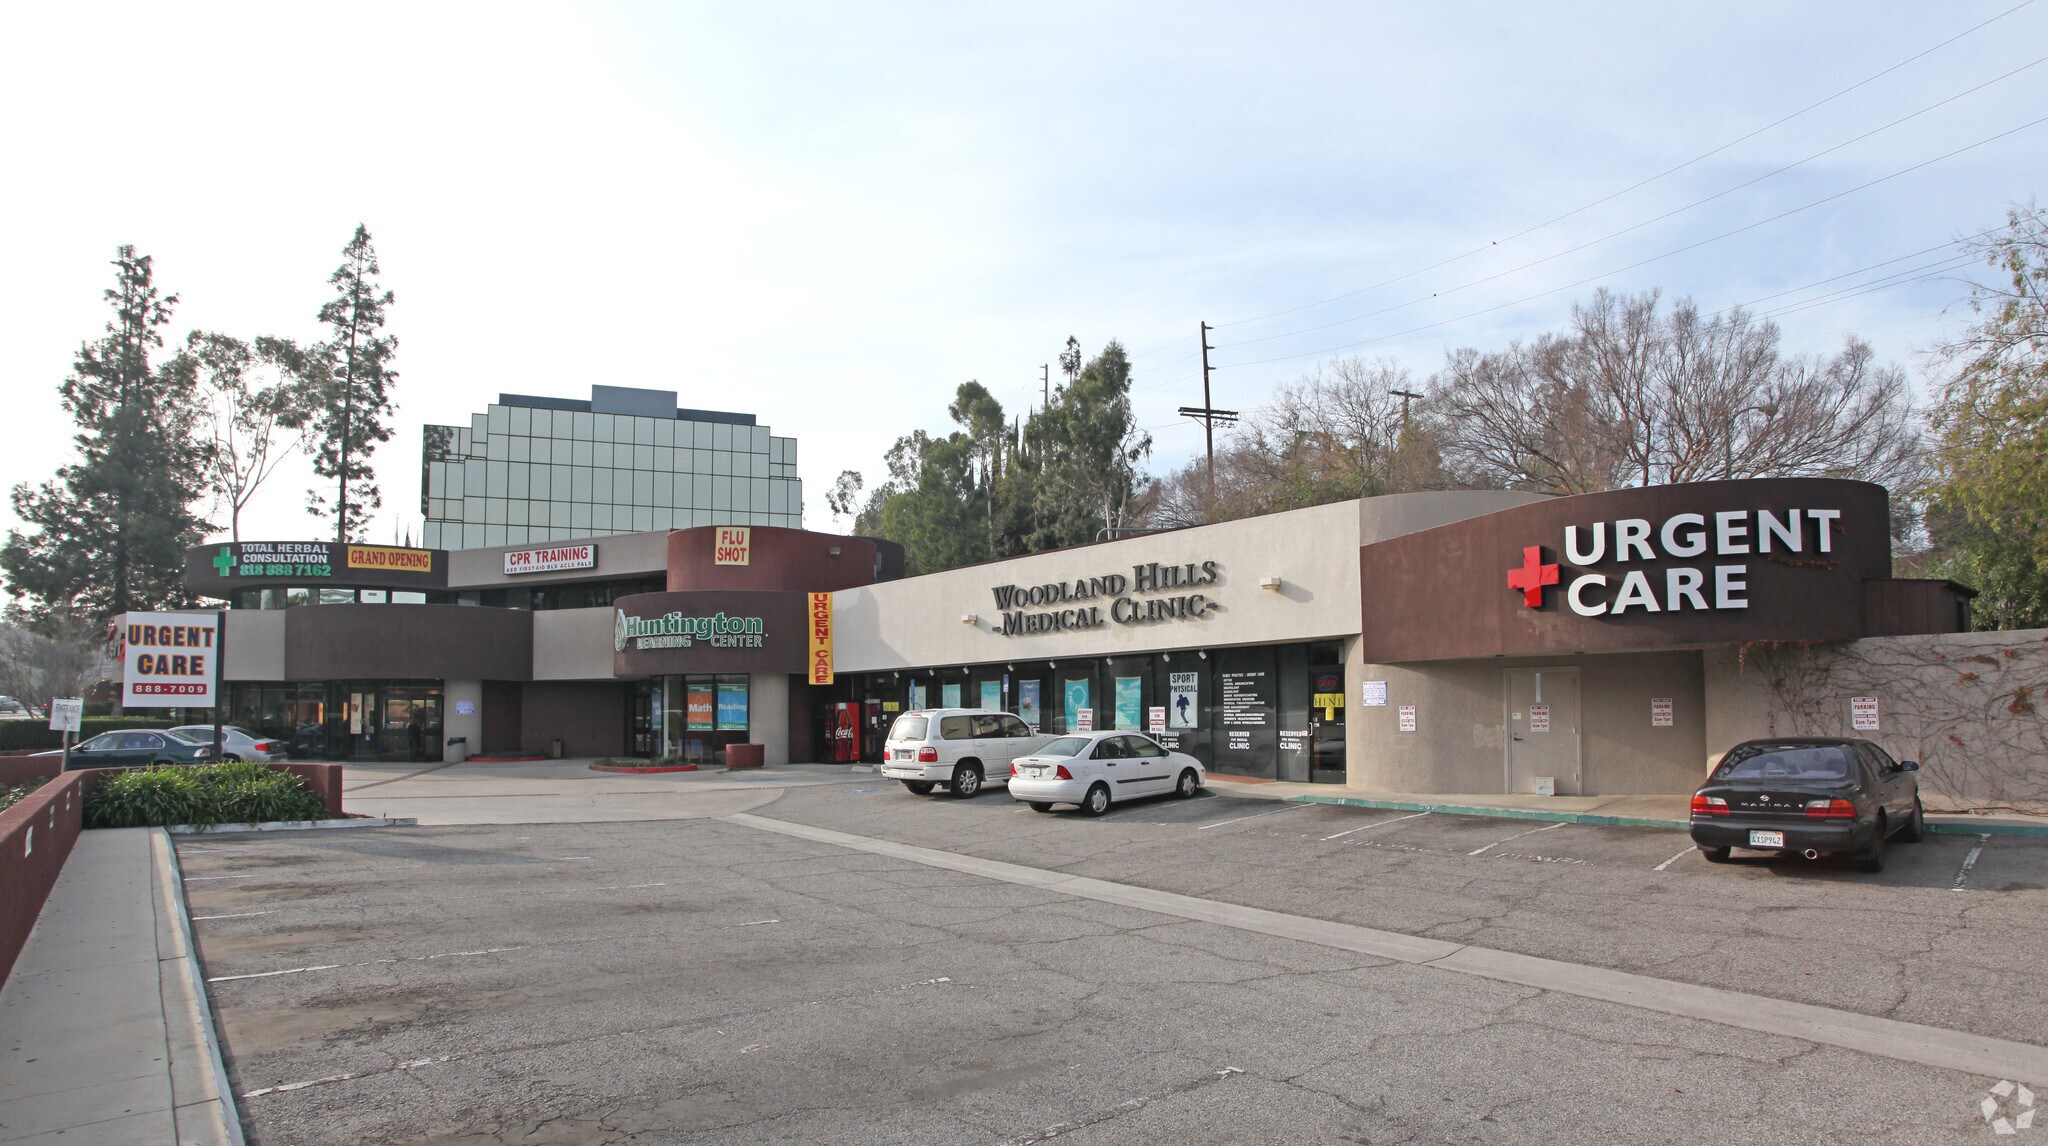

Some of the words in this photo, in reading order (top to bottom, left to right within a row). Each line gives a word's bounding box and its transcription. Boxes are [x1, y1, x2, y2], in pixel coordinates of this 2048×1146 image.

[721, 531, 744, 545] FLU
[1565, 509, 1841, 566] URGENT
[241, 544, 273, 553] TOTAL
[277, 544, 329, 554] HERBAL
[510, 552, 531, 565] CPR
[535, 547, 588, 563] TRAINING
[717, 547, 746, 562] SHOT
[243, 554, 327, 563] CONSULTATION
[351, 550, 386, 566] GRAND
[388, 552, 429, 568] OPENING
[239, 565, 263, 576] 818
[295, 565, 331, 577] 7162
[991, 574, 1126, 610] WOODLAND
[1132, 560, 1217, 592] HILLS
[1567, 564, 1749, 617] CARE
[626, 612, 763, 640] Huntington
[814, 594, 829, 645] URGENT
[127, 624, 216, 648] URGENT
[637, 635, 692, 650] LEARNING
[711, 635, 763, 647] CENTER
[137, 654, 205, 676] CARE
[815, 650, 829, 684] CARE
[1172, 674, 1195, 683] SPORT
[135, 684, 204, 693] 888-7009
[1170, 685, 1198, 693] PHYSICAL
[689, 704, 712, 712] Math
[718, 703, 747, 711] Reading
[1752, 836, 1781, 844] 4XSP942
